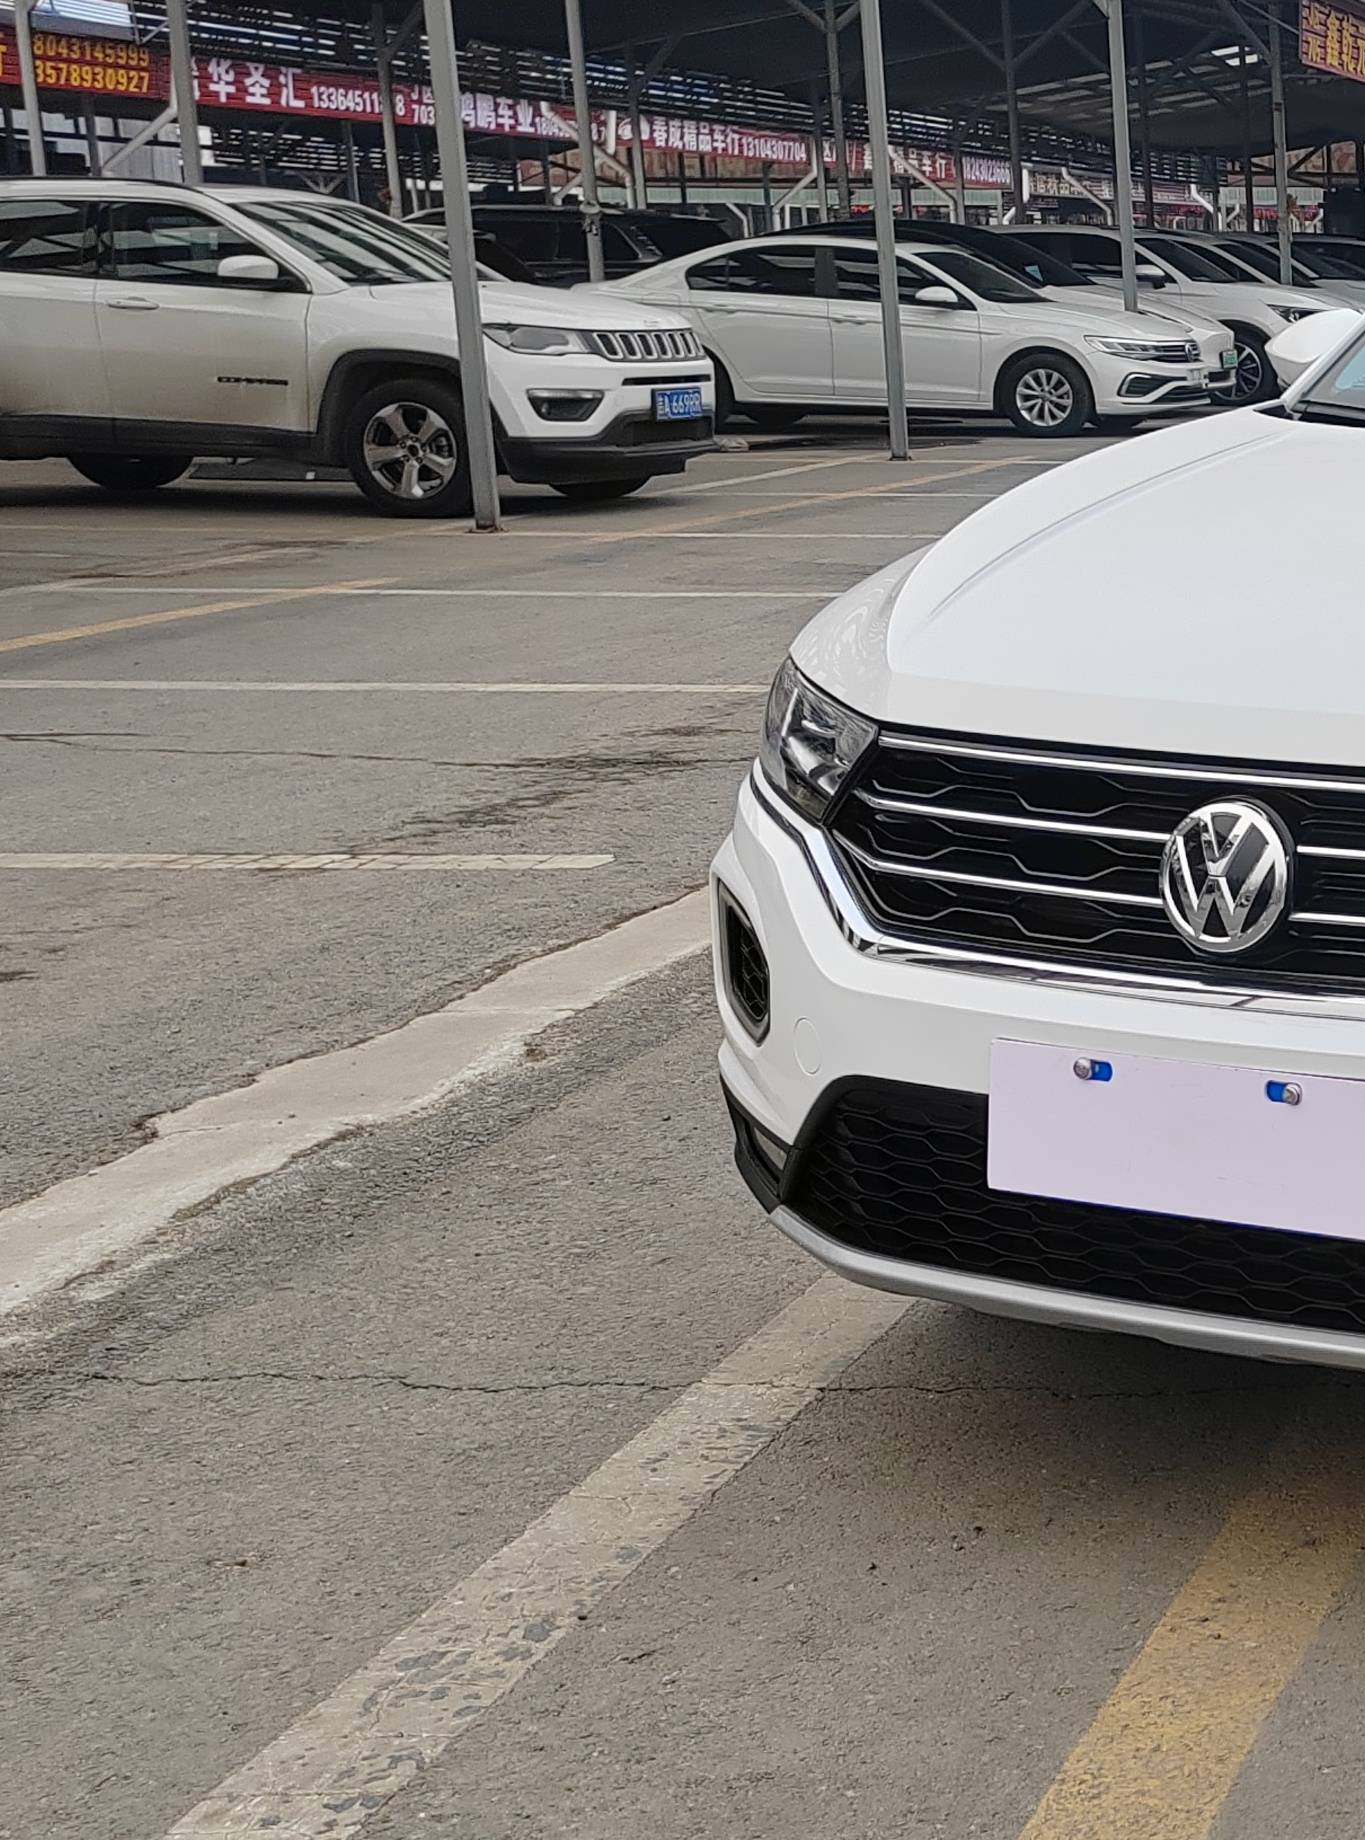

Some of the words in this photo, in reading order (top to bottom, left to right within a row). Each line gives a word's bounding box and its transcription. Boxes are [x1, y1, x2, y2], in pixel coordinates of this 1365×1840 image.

[33, 34, 149, 66] 8043145999
[35, 60, 149, 93] 3578930927
[310, 86, 406, 116] 133645118
